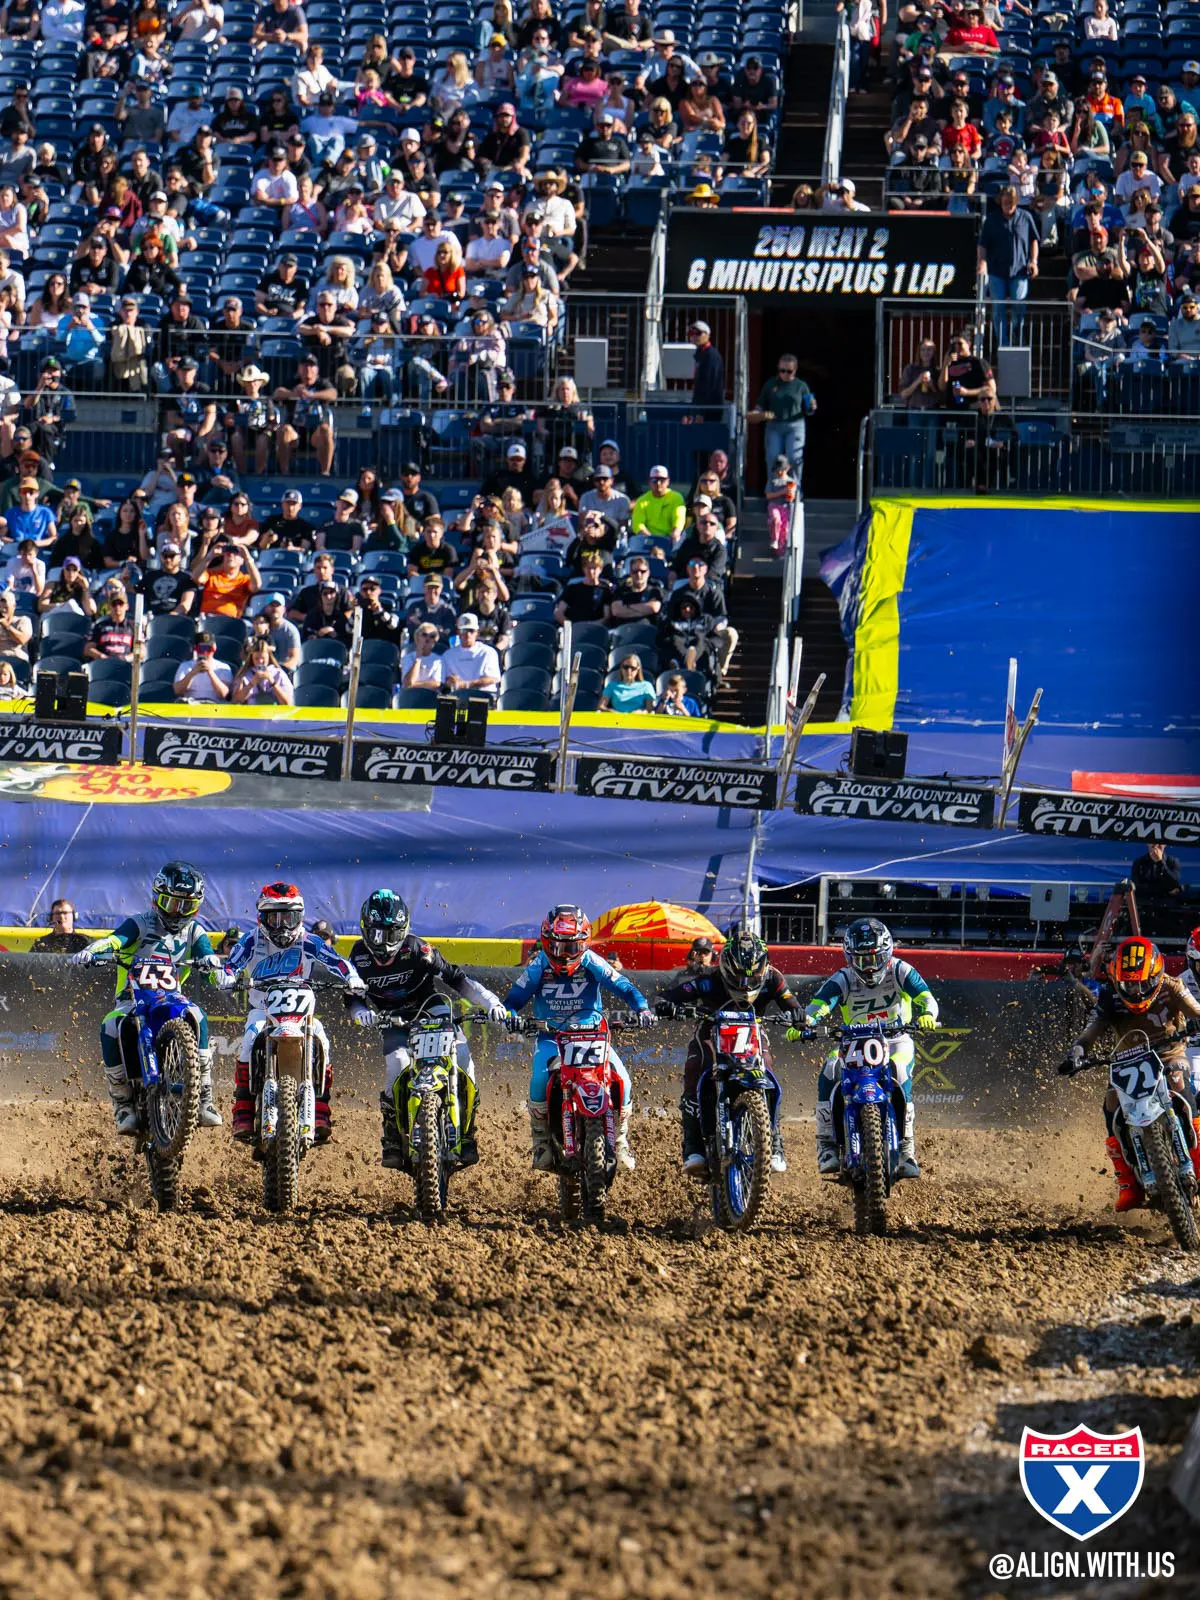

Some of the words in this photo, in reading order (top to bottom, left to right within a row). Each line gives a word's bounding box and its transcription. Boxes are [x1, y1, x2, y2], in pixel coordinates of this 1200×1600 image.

[754, 225, 805, 258] 250
[806, 226, 869, 259] HEAT
[868, 228, 889, 259] 2
[687, 258, 706, 291] 6
[708, 259, 888, 294] MINUTES/PLUS
[892, 262, 905, 293] 1
[907, 263, 956, 295] LAP
[15, 725, 105, 742] MOUNTAIN
[183, 732, 239, 749] ROCKY
[241, 737, 330, 757] MOUNTAIN
[391, 747, 449, 762] ROCKY
[449, 750, 539, 768] MOUNTAIN
[618, 762, 676, 778] ROCKY
[676, 766, 765, 786] MOUNTAIN
[72, 783, 198, 799] Shops
[836, 780, 893, 796] ROCKY
[891, 785, 982, 805] MOUNTAIN
[1058, 798, 1115, 815] ROCKY
[1115, 804, 1200, 825] MOUNTAIN
[140, 965, 178, 991] 43
[542, 983, 589, 998] FLY
[267, 988, 312, 1014] 237
[851, 992, 896, 1014] FLY
[412, 1032, 455, 1060] 388
[563, 1040, 606, 1066] 173
[732, 1026, 751, 1054] 1
[845, 1038, 885, 1067] 40
[1118, 1061, 1157, 1095] 71
